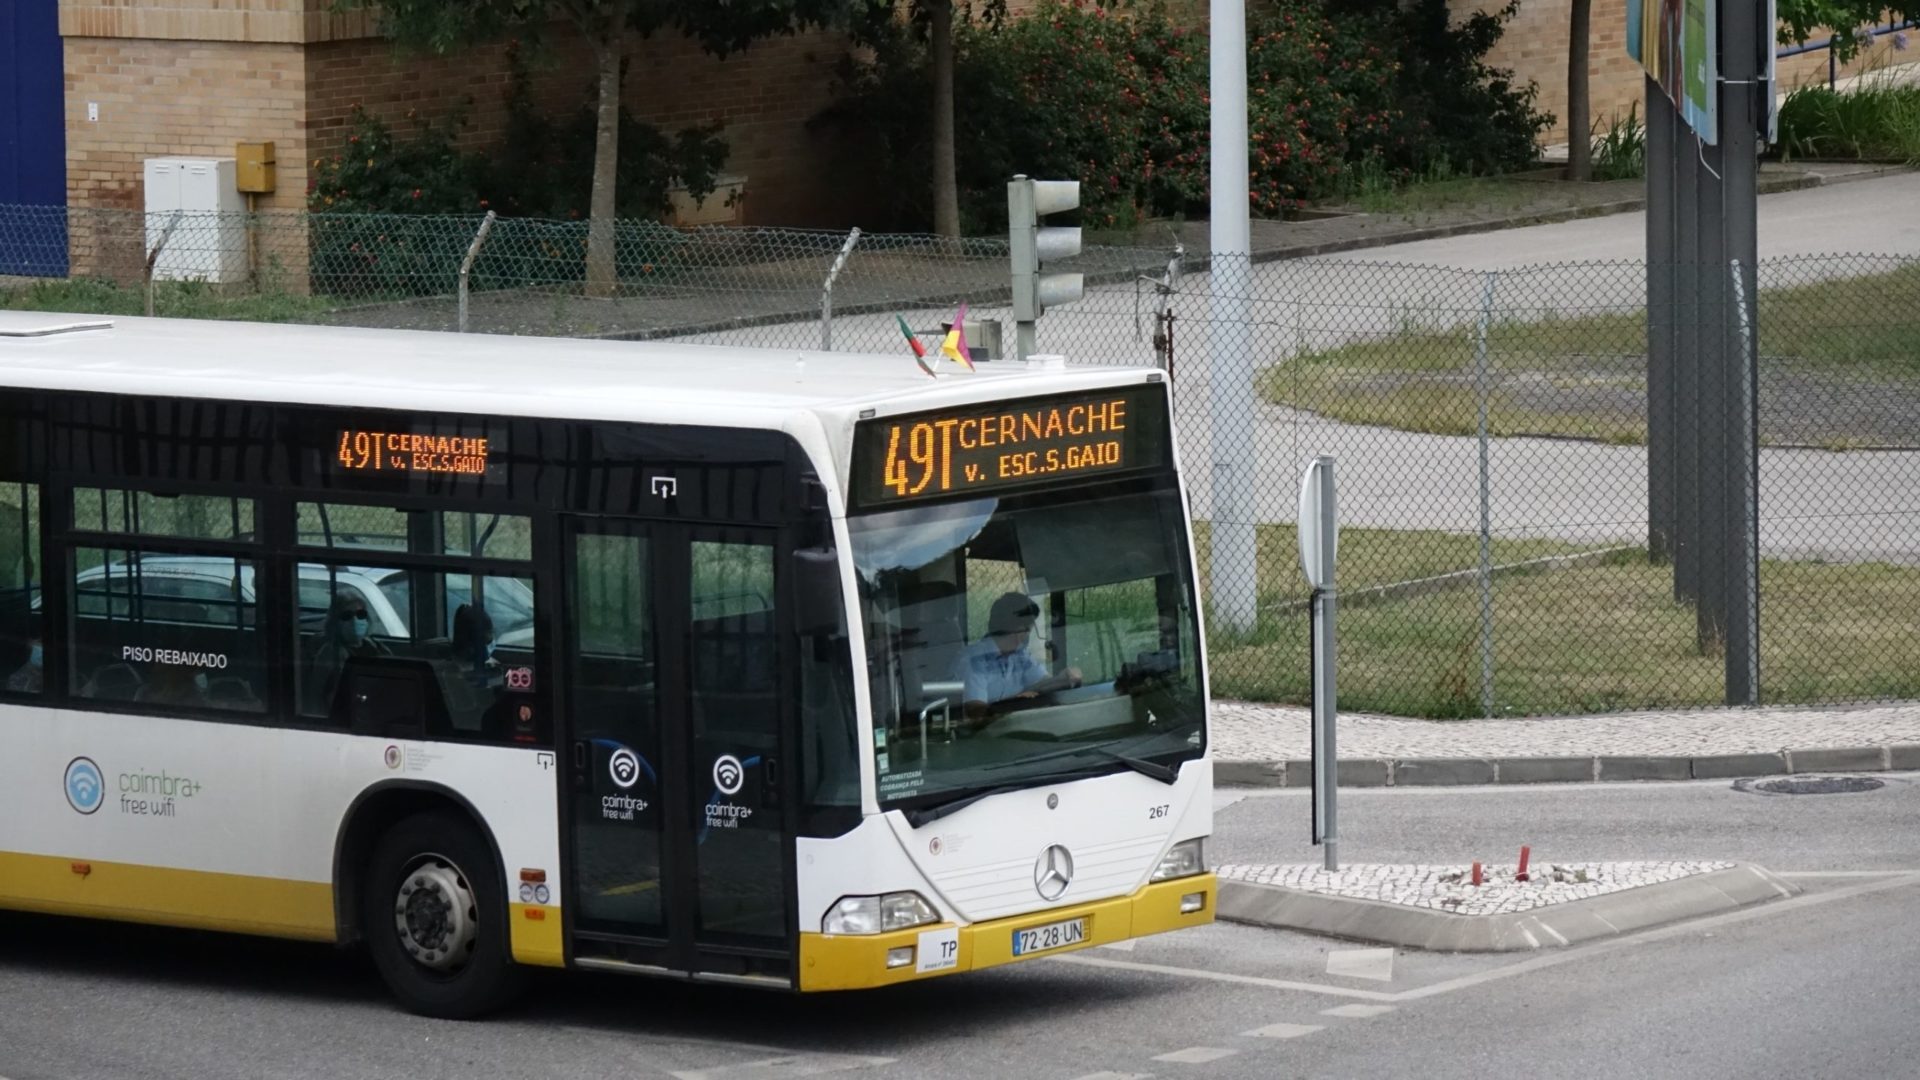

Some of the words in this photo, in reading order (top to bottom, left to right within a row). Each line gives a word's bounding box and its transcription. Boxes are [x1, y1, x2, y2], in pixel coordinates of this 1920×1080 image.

[339, 431, 385, 470] 49T
[387, 433, 488, 456] CERNACHE
[885, 419, 958, 496] 49T
[959, 400, 1126, 449] CERNACHE
[413, 453, 485, 474] ESC.S.GAIO
[965, 463, 986, 482] v.
[1000, 441, 1120, 477] ESC.S.GAIO
[123, 646, 152, 662] PISO
[155, 649, 227, 668] REBAIXADO
[121, 793, 148, 815] free
[150, 797, 176, 817] wifi
[603, 808, 619, 819] free
[619, 810, 634, 821] wifi
[1149, 804, 1170, 819] 267
[707, 816, 723, 828] free
[722, 818, 738, 829] wifi
[941, 940, 958, 959] TP
